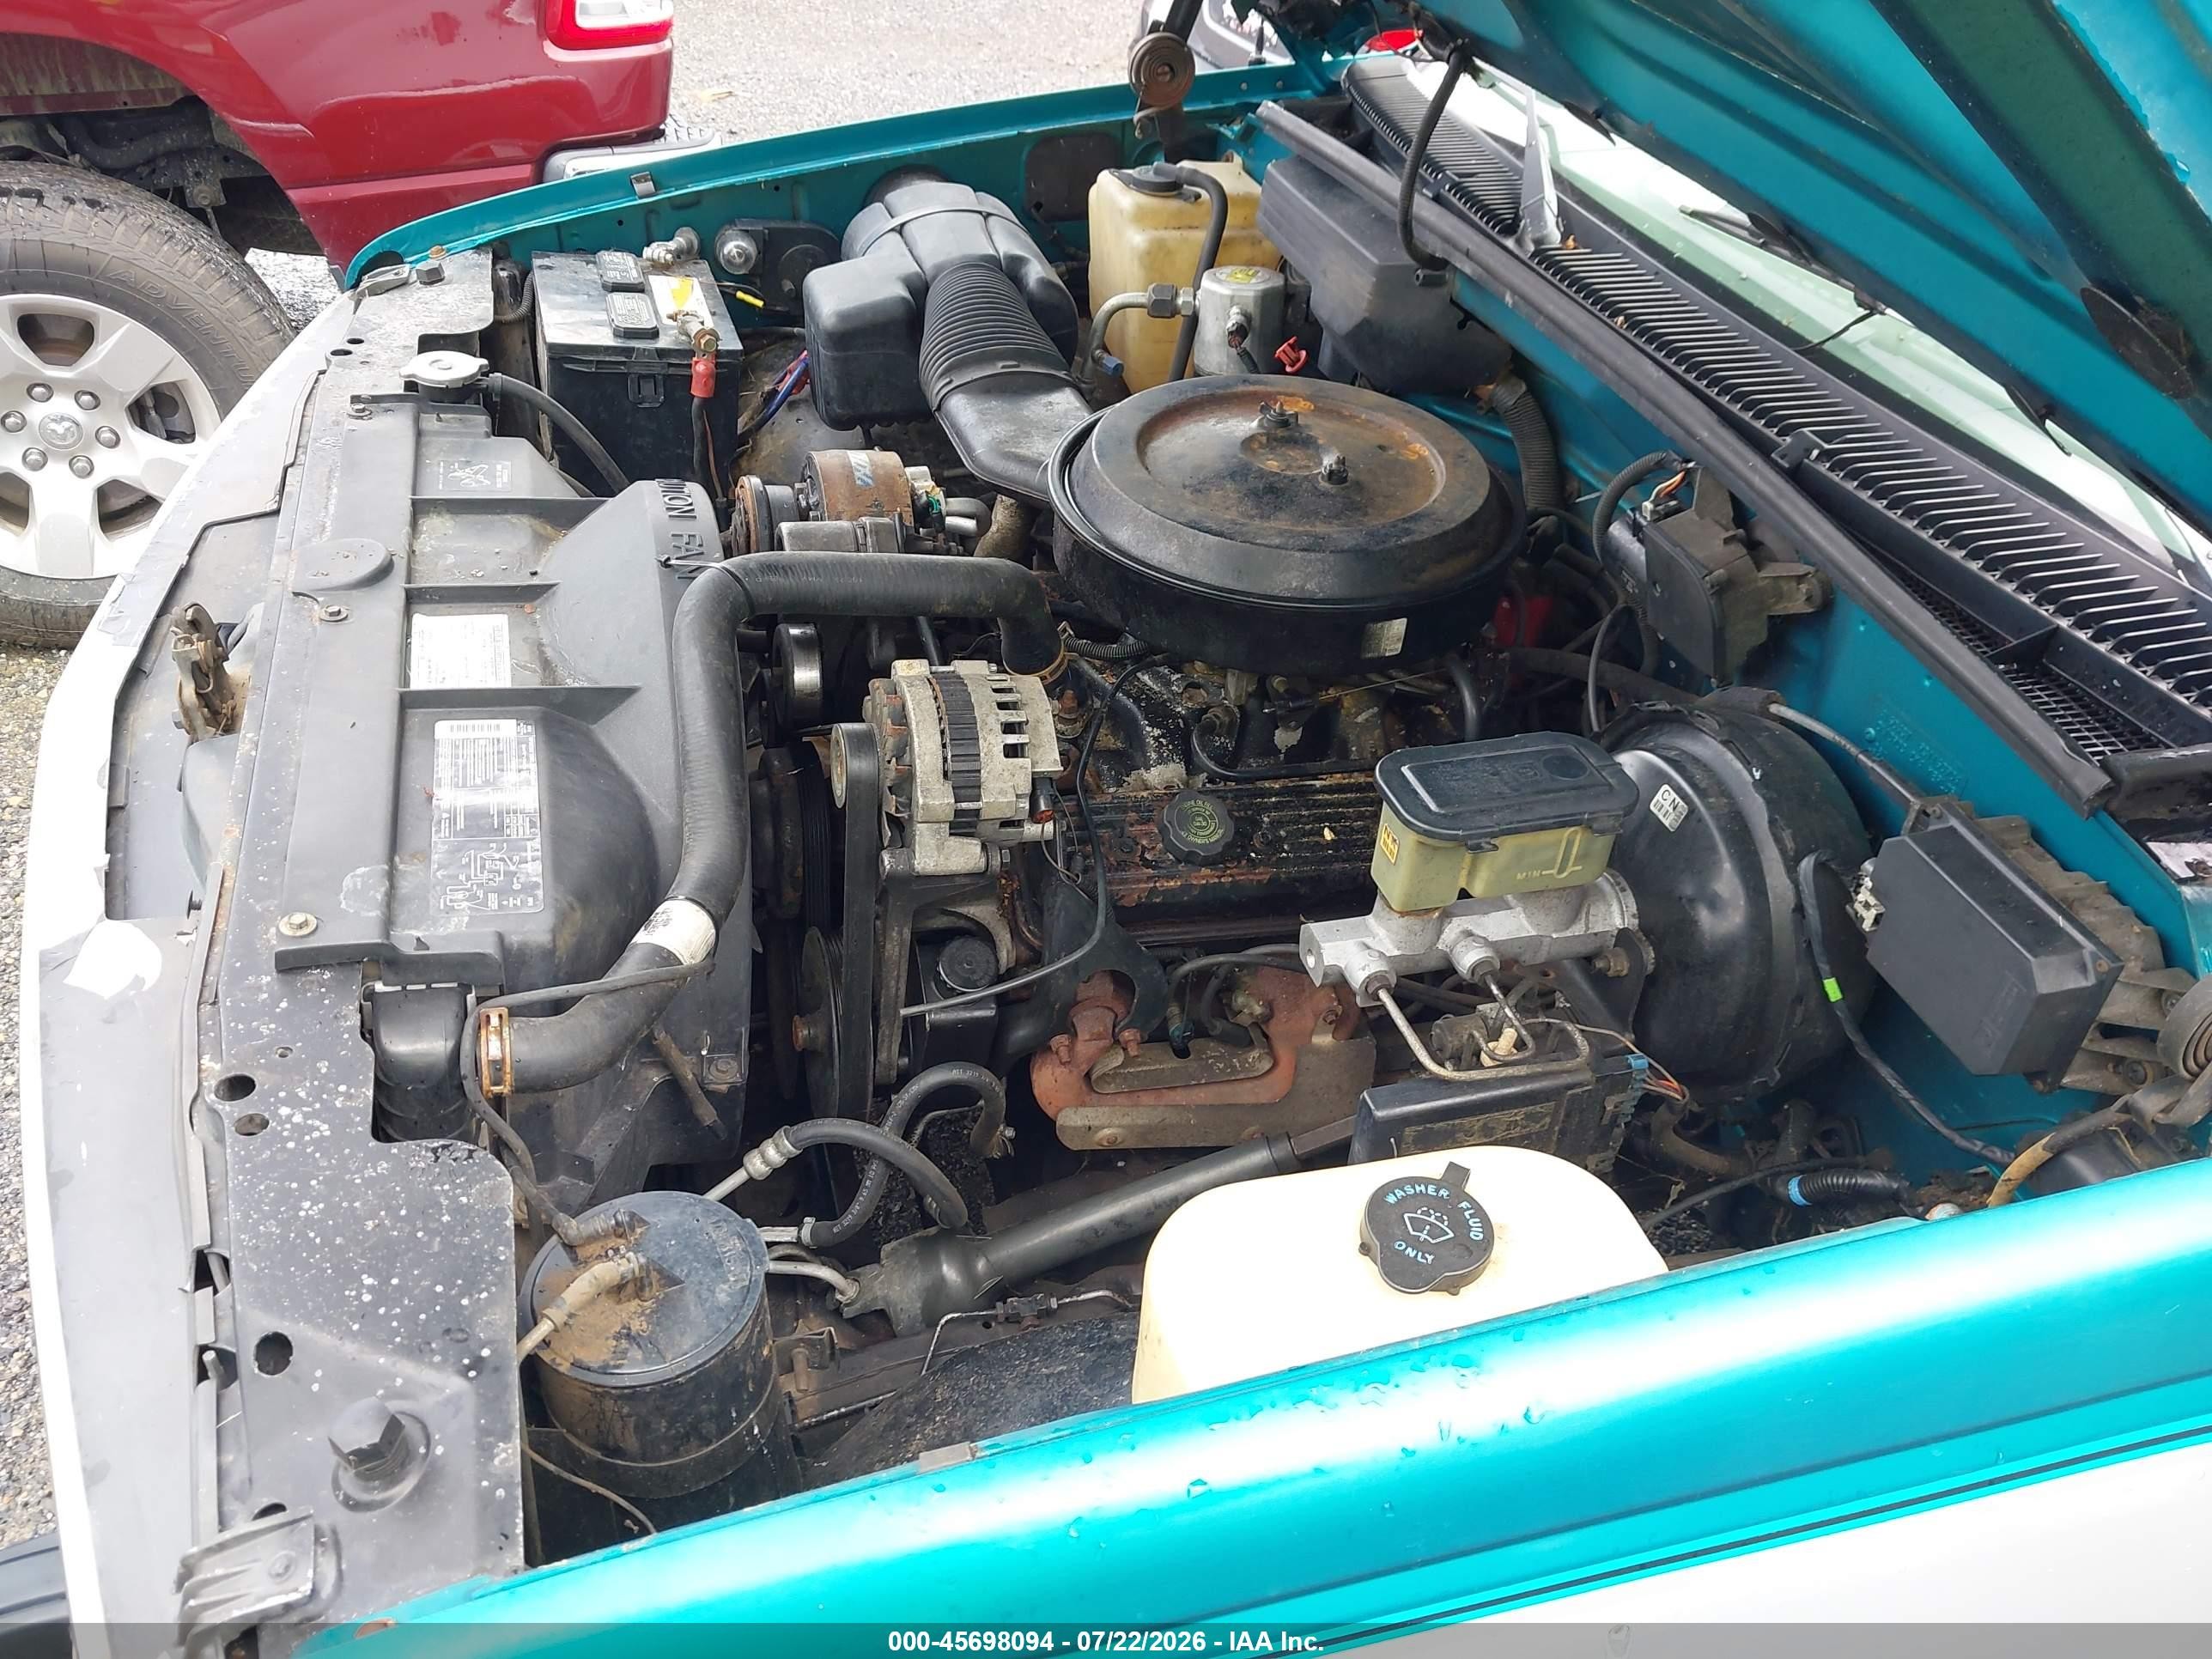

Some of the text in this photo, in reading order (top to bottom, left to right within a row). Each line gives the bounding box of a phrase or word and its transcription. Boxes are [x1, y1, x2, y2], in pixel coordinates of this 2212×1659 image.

[655, 478, 697, 519] UTION
[1516, 869, 1540, 880] MIN
[1383, 1183, 1484, 1241] WASHER FLUID
[1394, 1241, 1436, 1265] ONLY
